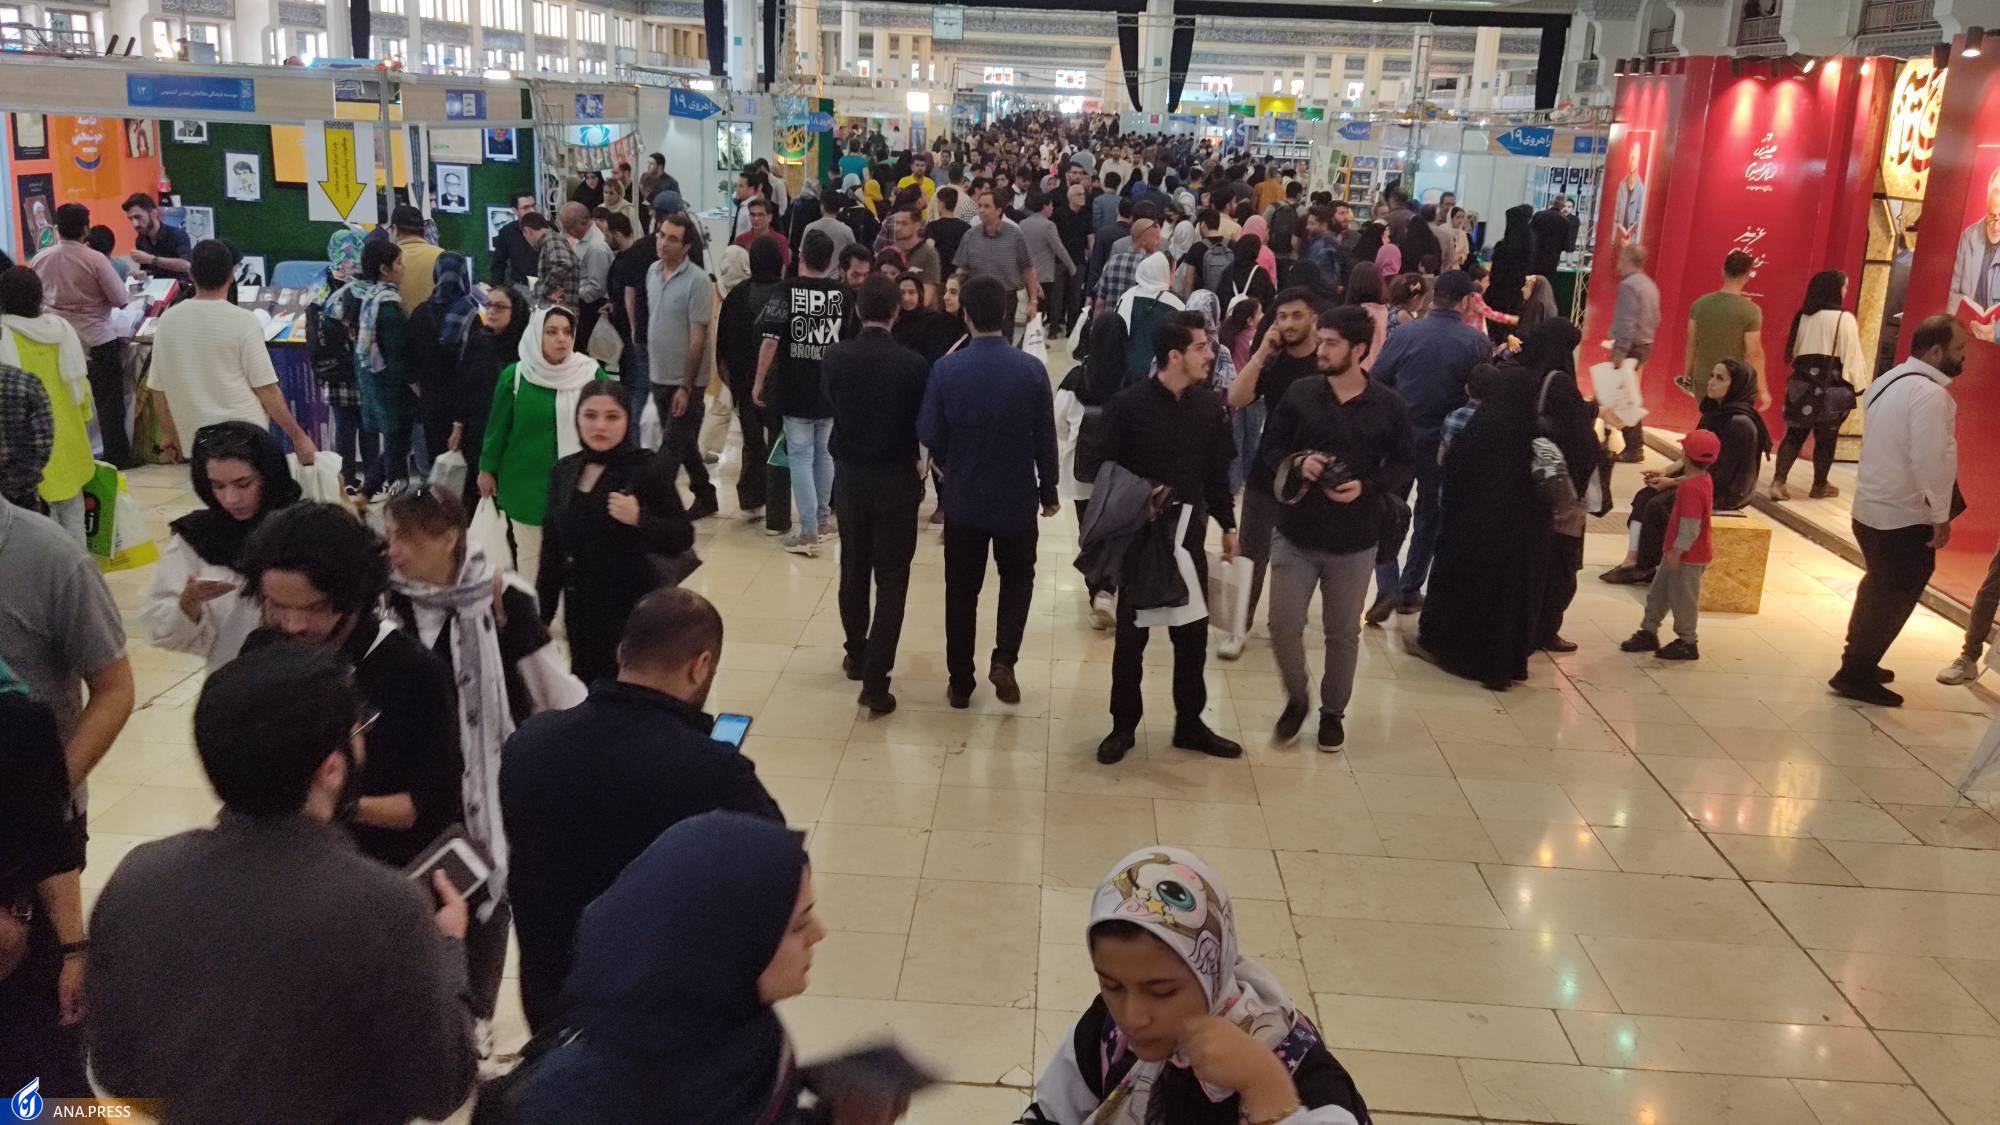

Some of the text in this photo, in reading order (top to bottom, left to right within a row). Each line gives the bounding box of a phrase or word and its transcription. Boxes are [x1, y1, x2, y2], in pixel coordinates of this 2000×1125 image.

[674, 93, 687, 109] ۱۹
[1510, 129, 1523, 144] ۱۹
[793, 288, 807, 313] THE
